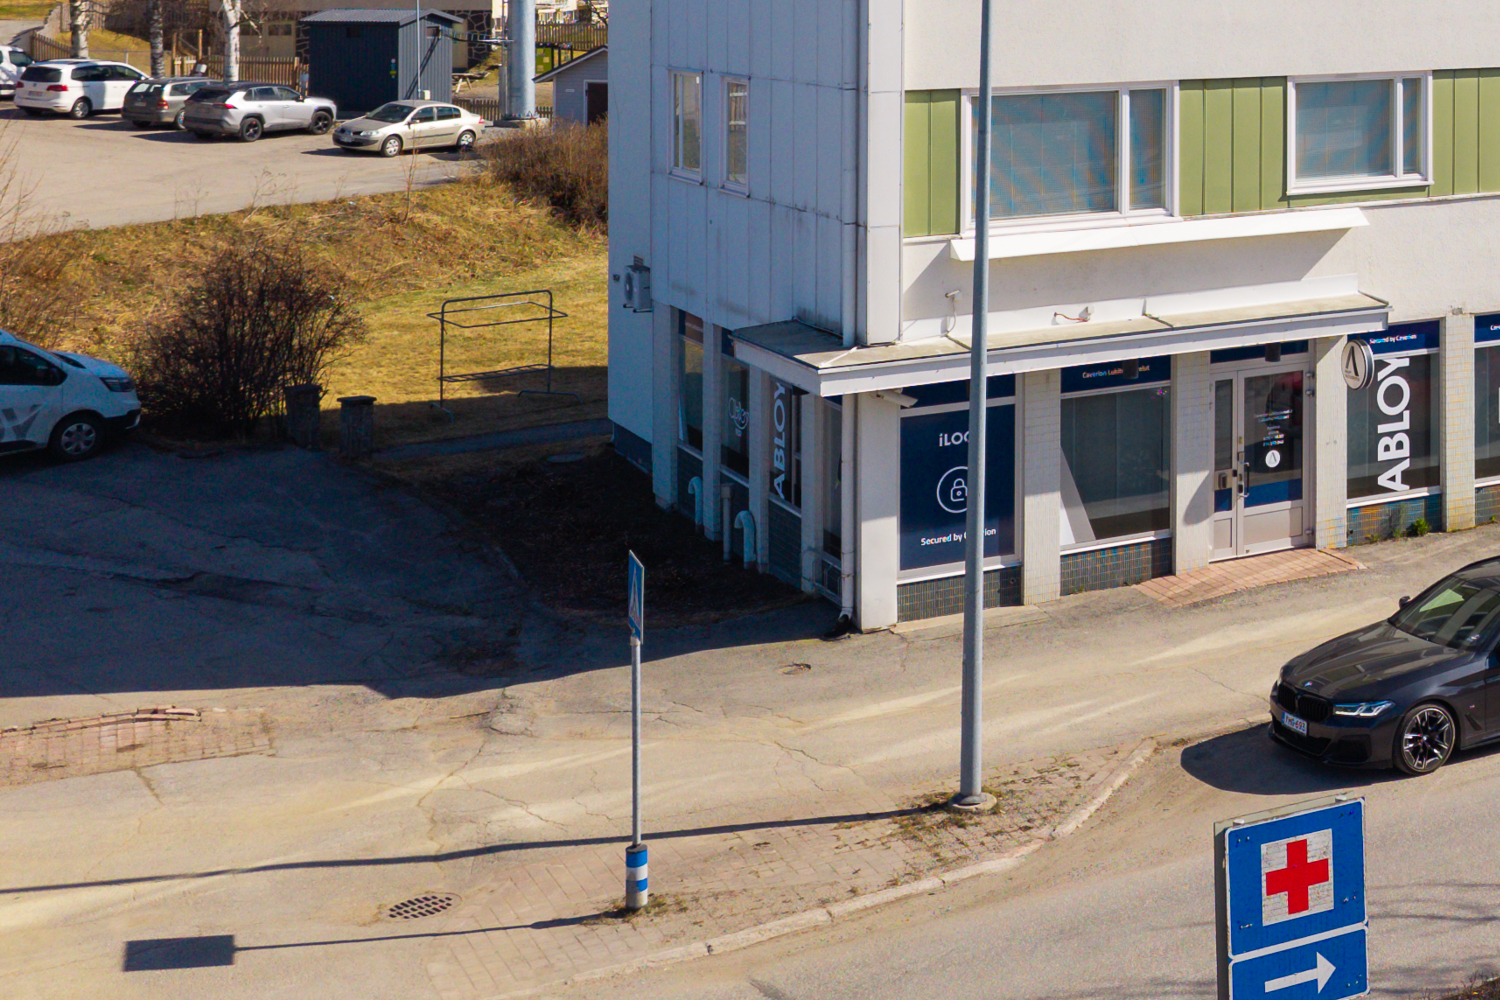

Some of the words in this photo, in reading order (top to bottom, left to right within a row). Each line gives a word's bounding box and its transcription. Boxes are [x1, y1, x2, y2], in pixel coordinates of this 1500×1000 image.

[1082, 368, 1107, 379] Caverion
[773, 382, 786, 500] ABLOY
[1376, 357, 1411, 492] ABLOY
[920, 533, 952, 546] Secured
[953, 532, 963, 543] by
